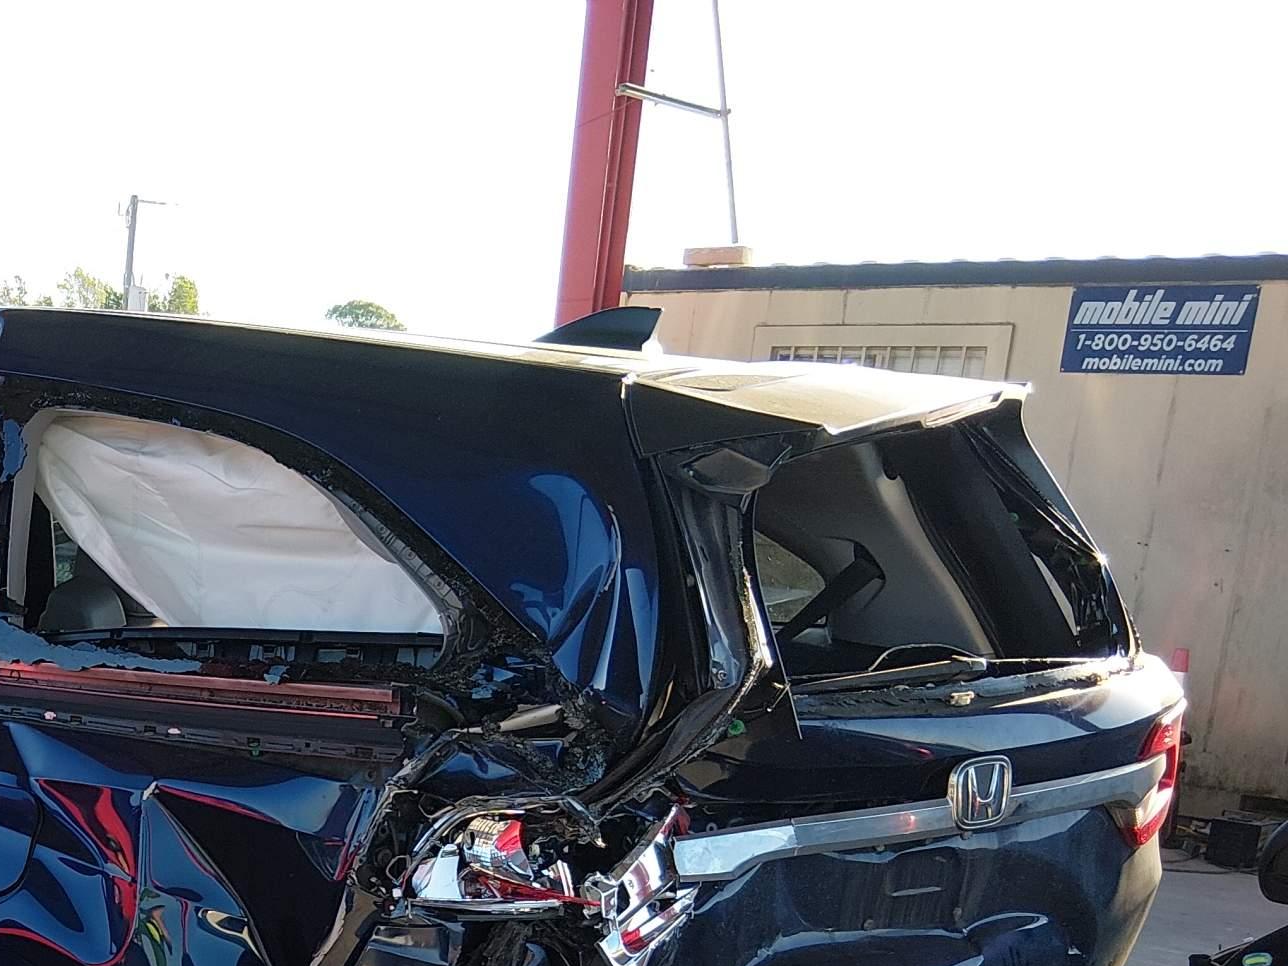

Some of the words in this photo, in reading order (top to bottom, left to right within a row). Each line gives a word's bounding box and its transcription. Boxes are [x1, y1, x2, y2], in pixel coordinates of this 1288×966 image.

[1073, 290, 1176, 325] mobile
[1176, 294, 1252, 325] mini
[1076, 334, 1237, 351] 1-800-950-6464
[1081, 354, 1224, 372] mobilemini.com
